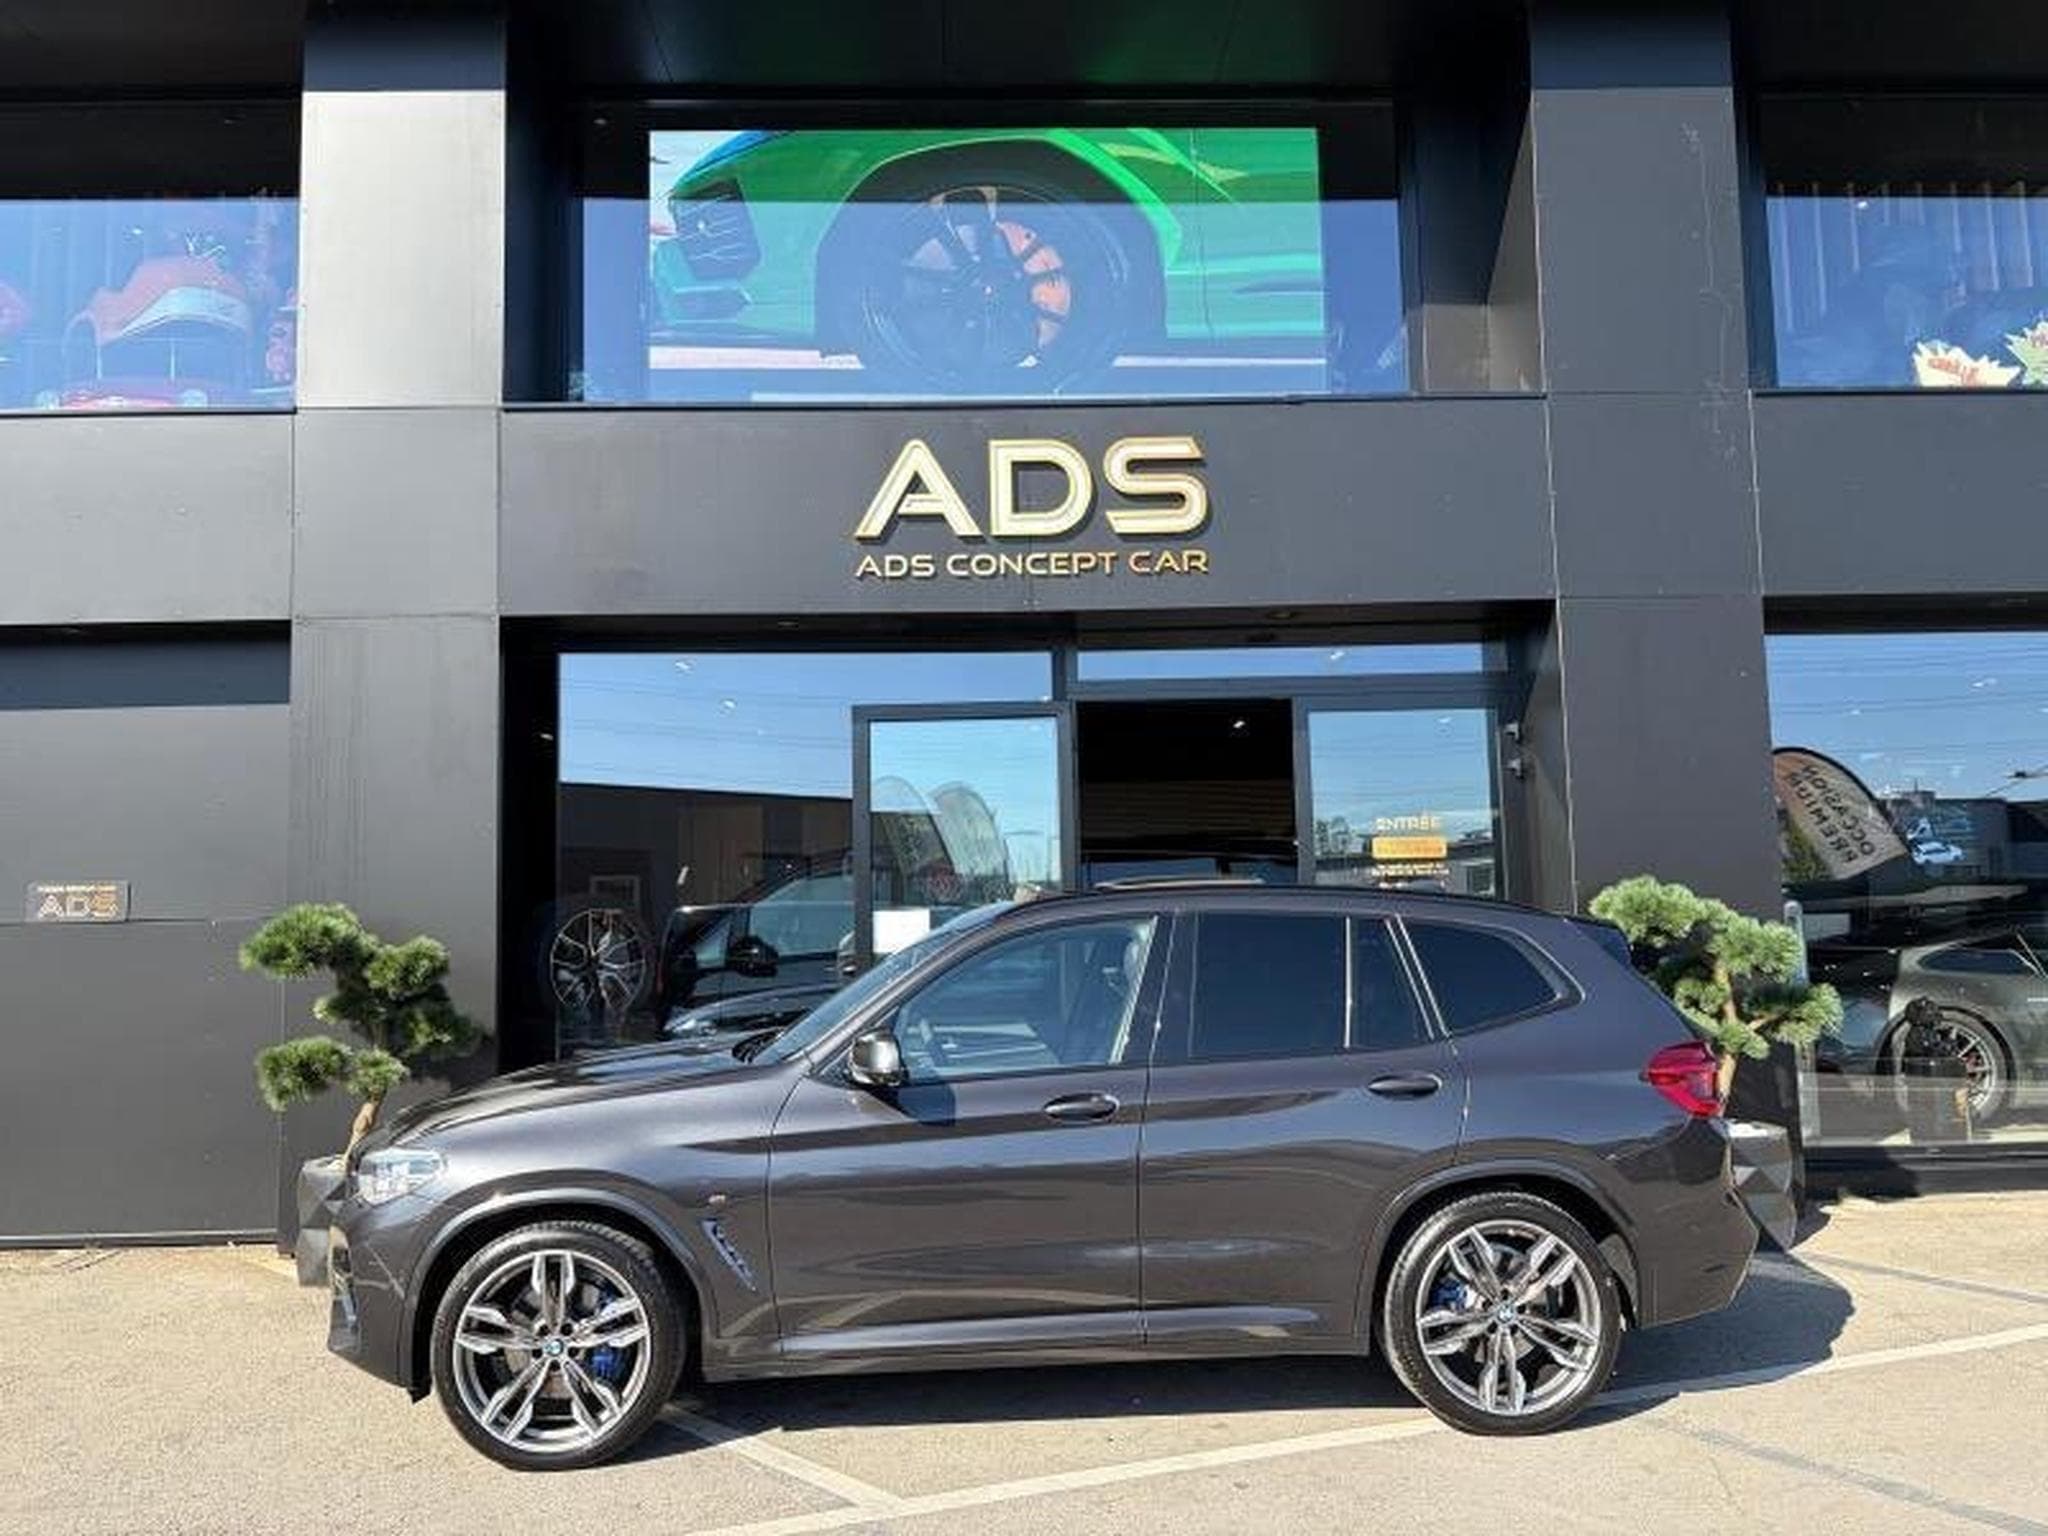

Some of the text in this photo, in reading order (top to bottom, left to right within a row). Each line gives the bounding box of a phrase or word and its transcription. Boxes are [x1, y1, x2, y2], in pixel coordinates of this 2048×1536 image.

[854, 436, 1208, 538] ADS
[855, 549, 1210, 578] ADS CONCEPT CAR
[38, 894, 118, 918] ADS
